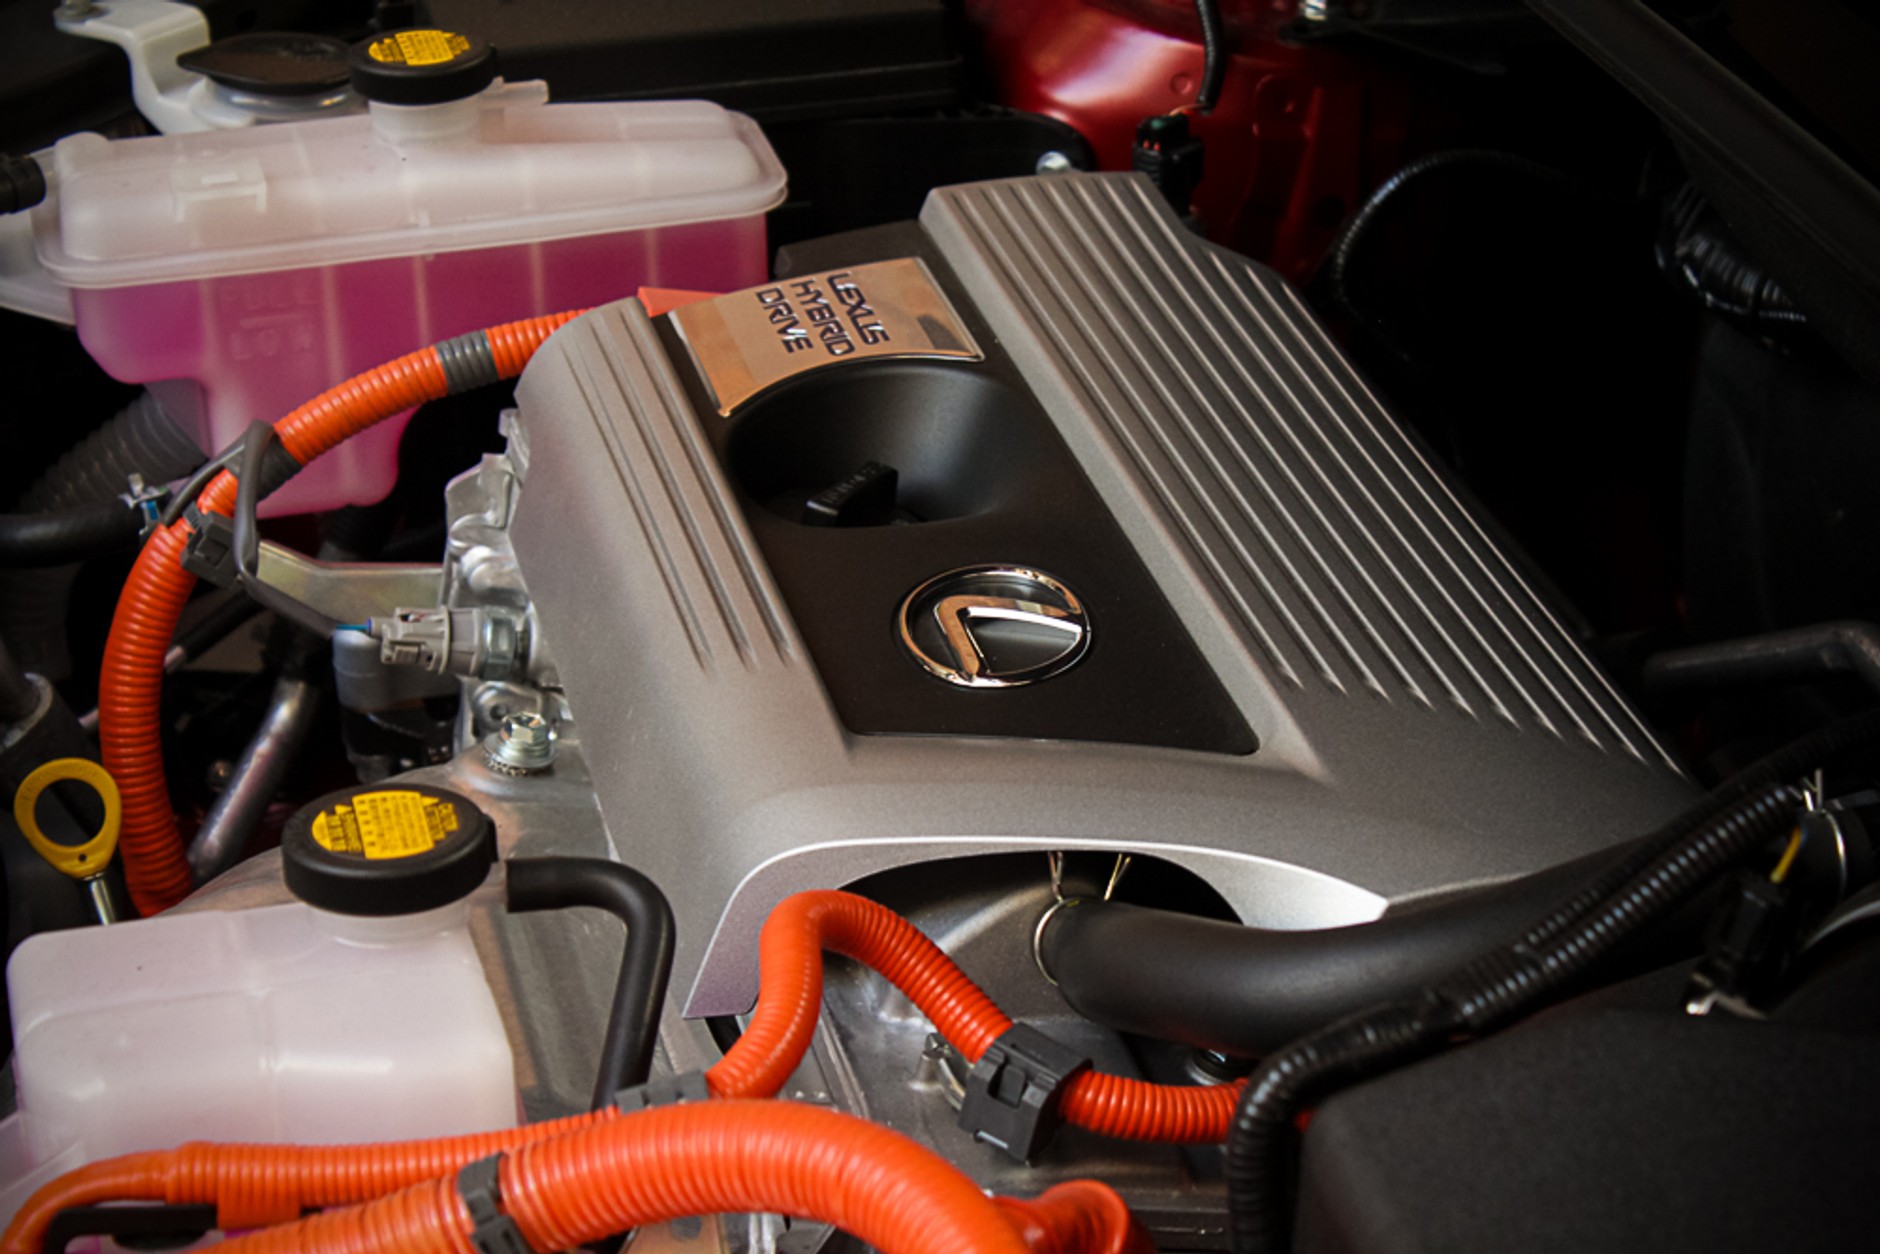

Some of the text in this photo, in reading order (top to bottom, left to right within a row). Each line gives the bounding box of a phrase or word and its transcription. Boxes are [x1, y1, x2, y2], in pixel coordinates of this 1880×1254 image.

[757, 287, 812, 353] DRIVE
[791, 280, 855, 356] HYBRID
[827, 273, 889, 345] LEXUS
